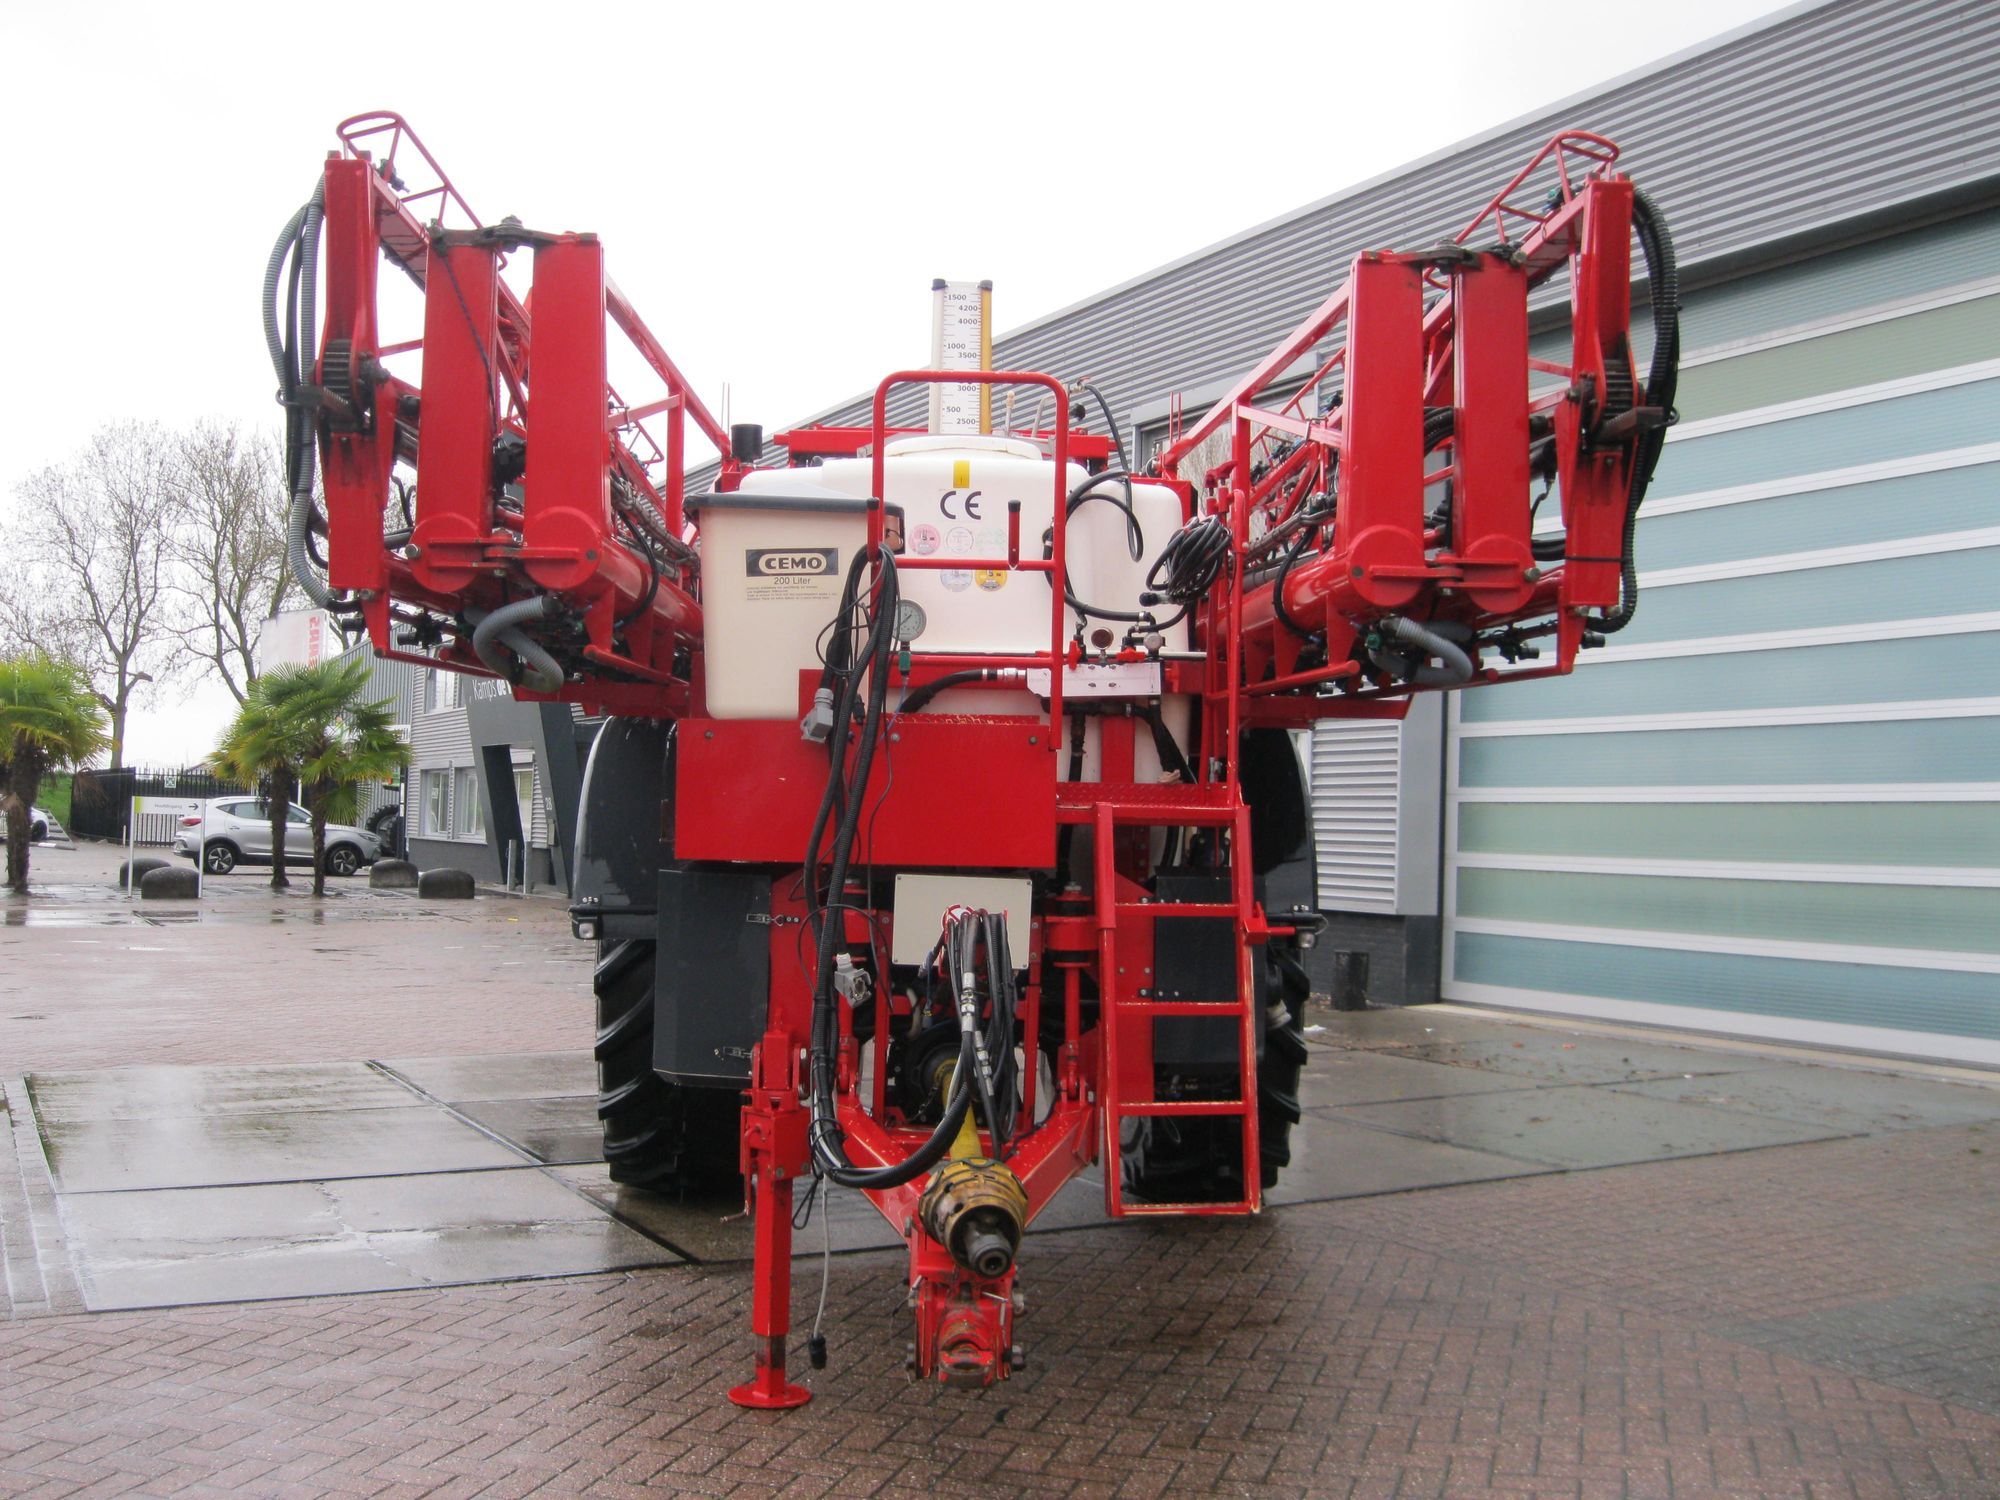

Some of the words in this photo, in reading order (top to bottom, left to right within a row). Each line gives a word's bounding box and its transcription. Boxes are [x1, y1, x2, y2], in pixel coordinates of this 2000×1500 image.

[940, 490, 982, 520] CE
[764, 557, 822, 570] CEMO
[773, 577, 790, 585] 200
[792, 577, 811, 585] Liter
[472, 679, 497, 702] Kamps
